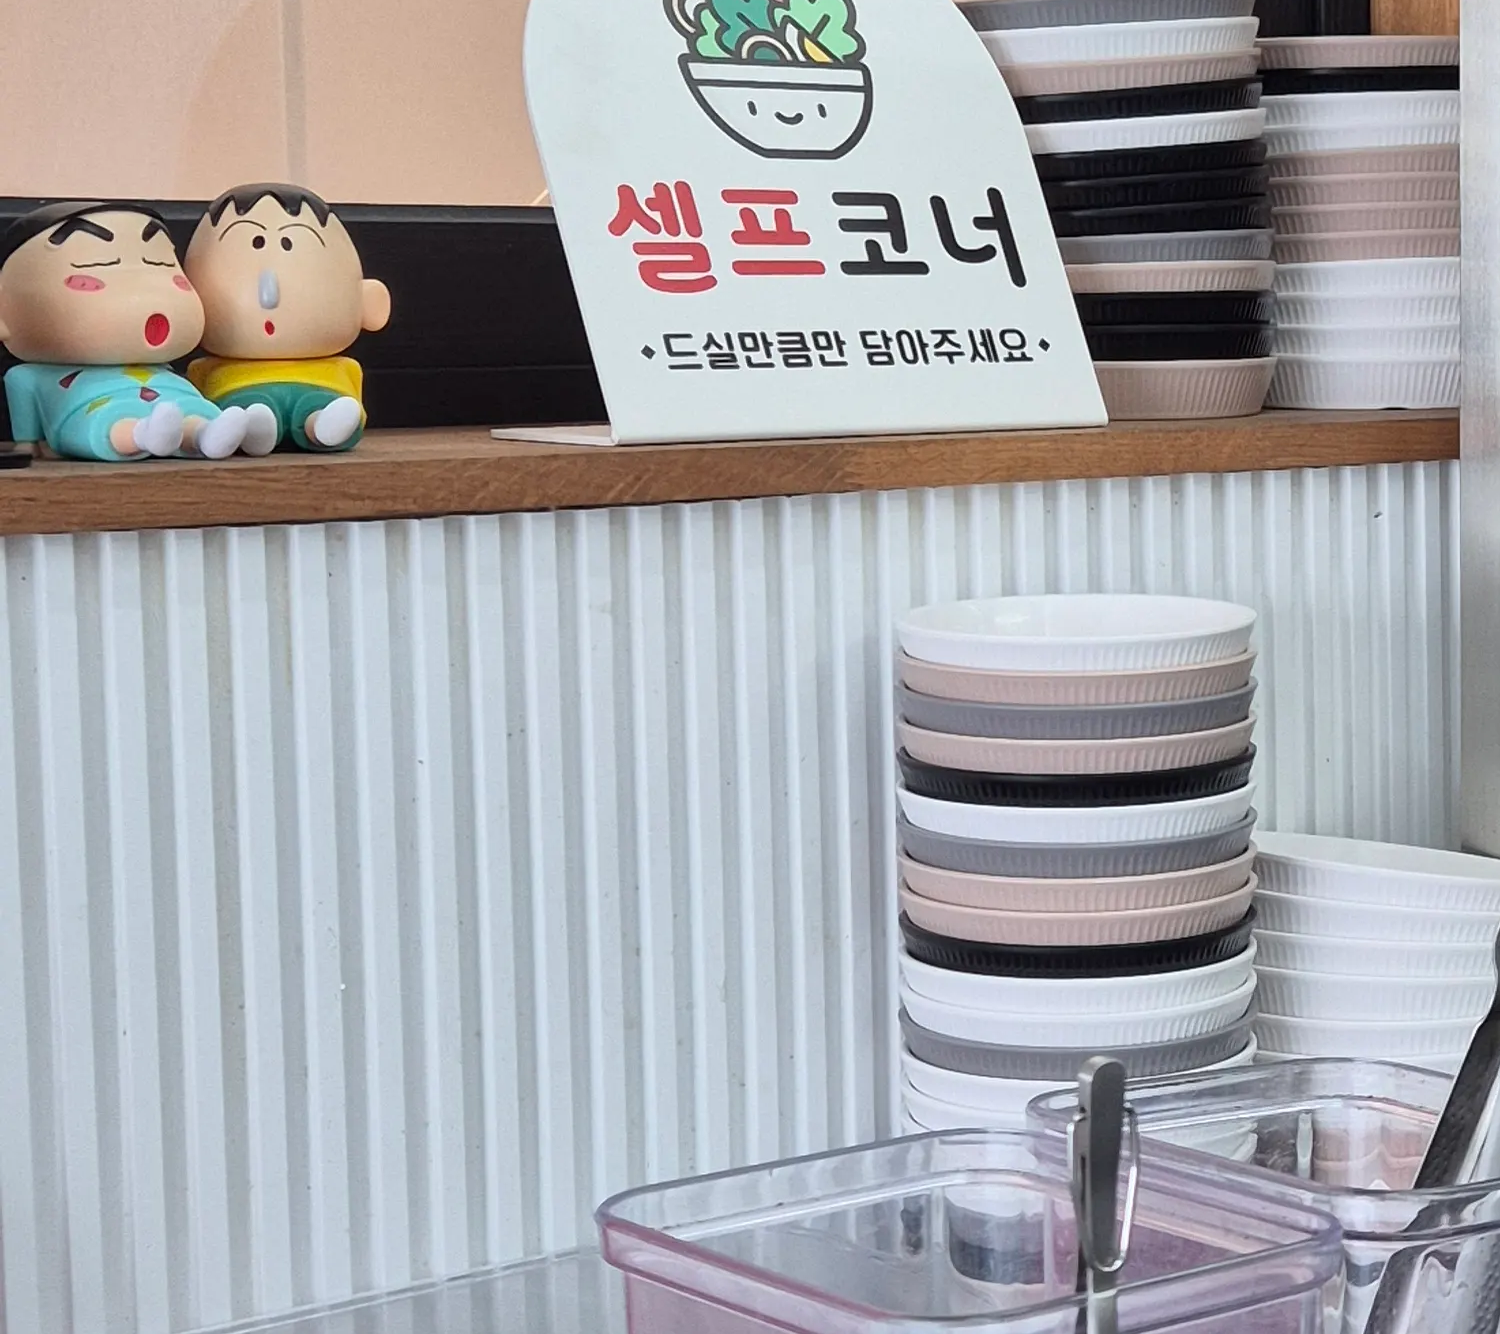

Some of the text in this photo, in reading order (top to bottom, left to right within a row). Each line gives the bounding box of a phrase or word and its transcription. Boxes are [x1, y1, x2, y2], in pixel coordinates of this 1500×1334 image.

[607, 179, 1027, 294] 셀프코너
[661, 327, 1035, 370] 드실만큼만 담아주세요
